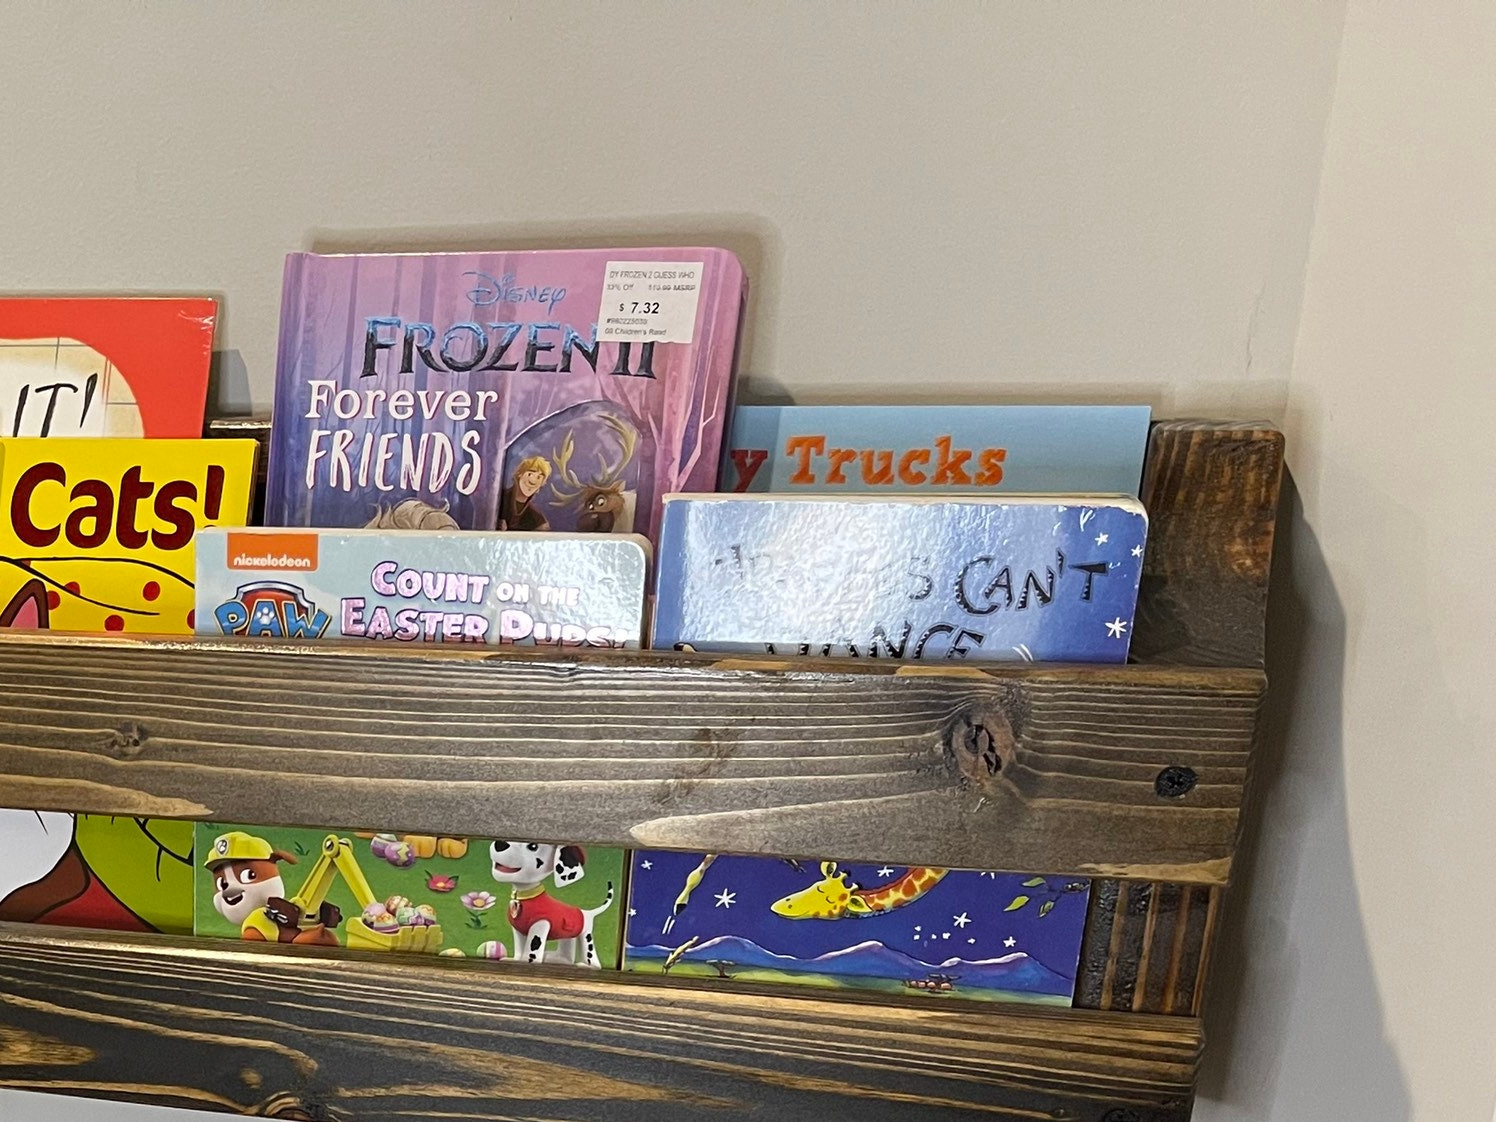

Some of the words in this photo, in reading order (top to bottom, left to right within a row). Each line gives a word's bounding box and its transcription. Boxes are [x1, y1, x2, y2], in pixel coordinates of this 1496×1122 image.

[631, 302, 660, 314] 7.32
[360, 316, 599, 379] FROZEN
[305, 380, 498, 421] Forever
[306, 428, 481, 495] FRIENDS
[786, 434, 1007, 487] Trucks
[10, 461, 225, 551] Cats!
[233, 552, 312, 568] nickelodeon
[370, 560, 489, 605] COUNT
[496, 583, 530, 605] ON
[956, 548, 1108, 616] CAN'T
[214, 599, 333, 639] PAW
[340, 597, 488, 643] EASTER
